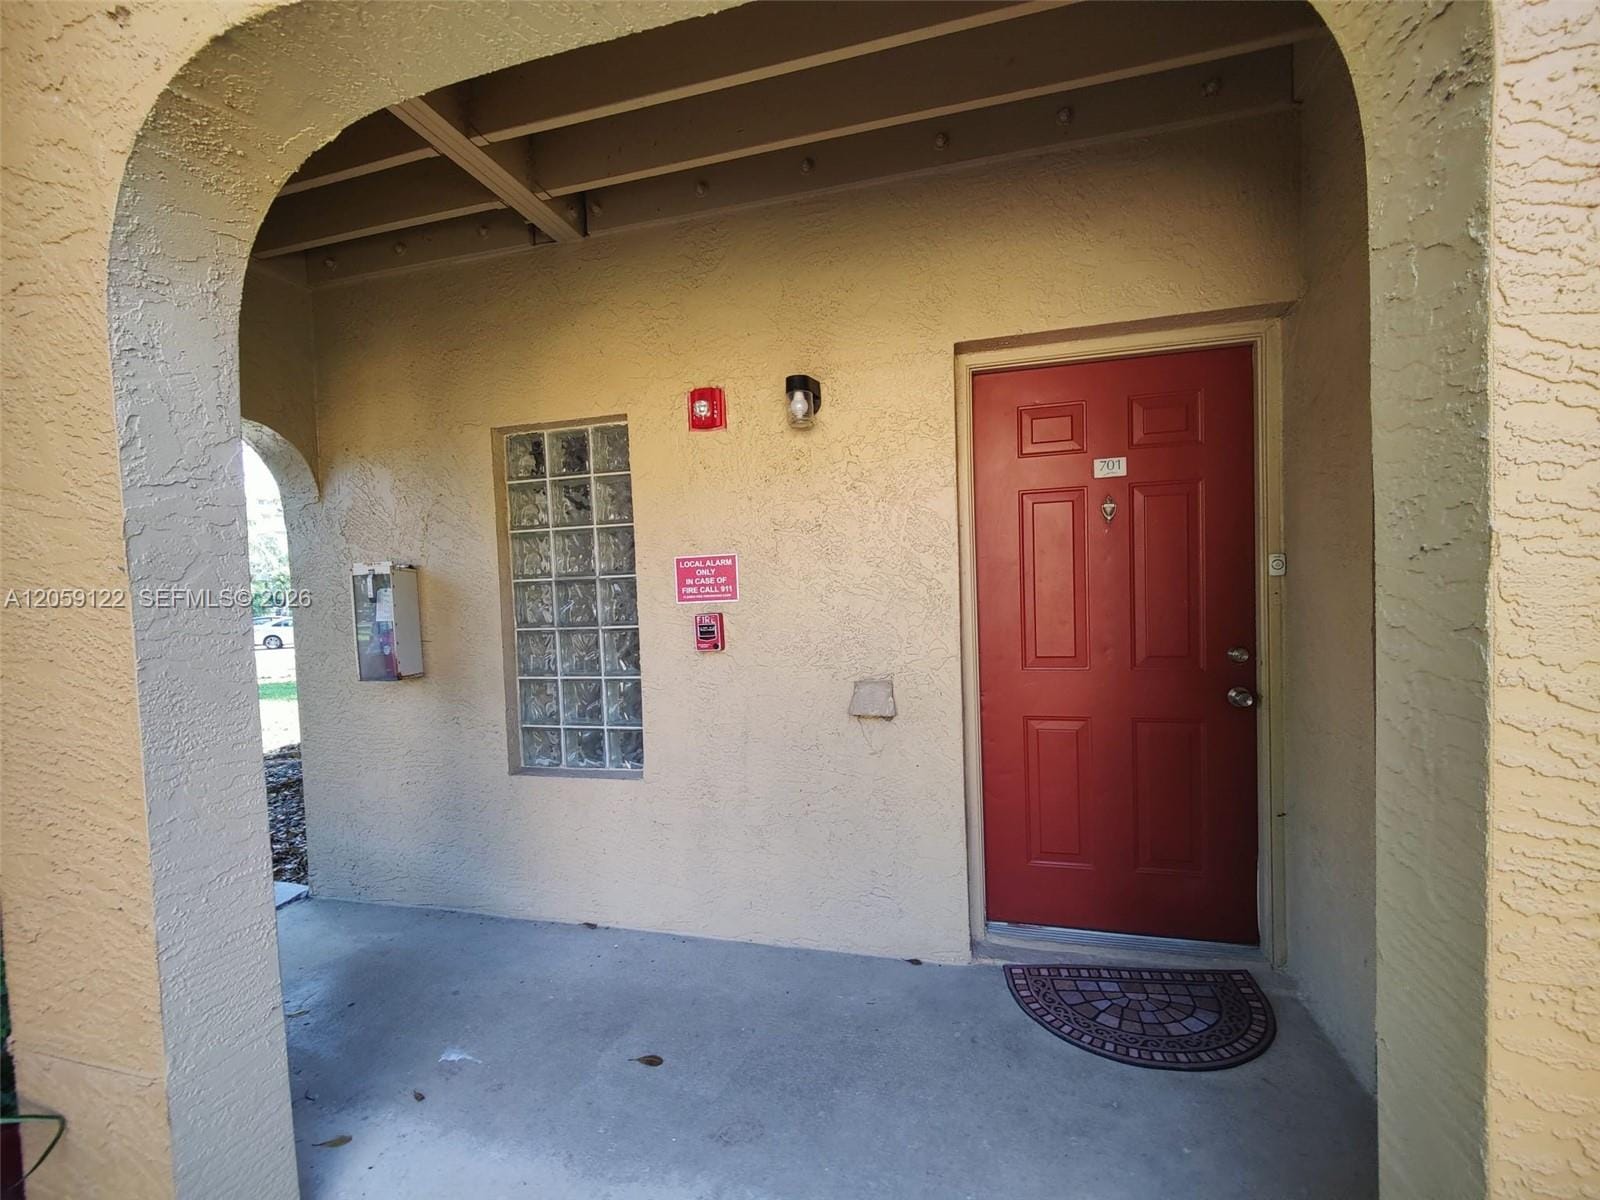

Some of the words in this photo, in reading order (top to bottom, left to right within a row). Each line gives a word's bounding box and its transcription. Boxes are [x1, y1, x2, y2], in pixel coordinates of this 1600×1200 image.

[1099, 459, 1121, 471] 701
[705, 559, 733, 567] ALARM
[695, 568, 716, 576] ONLY
[716, 576, 727, 584] OF
